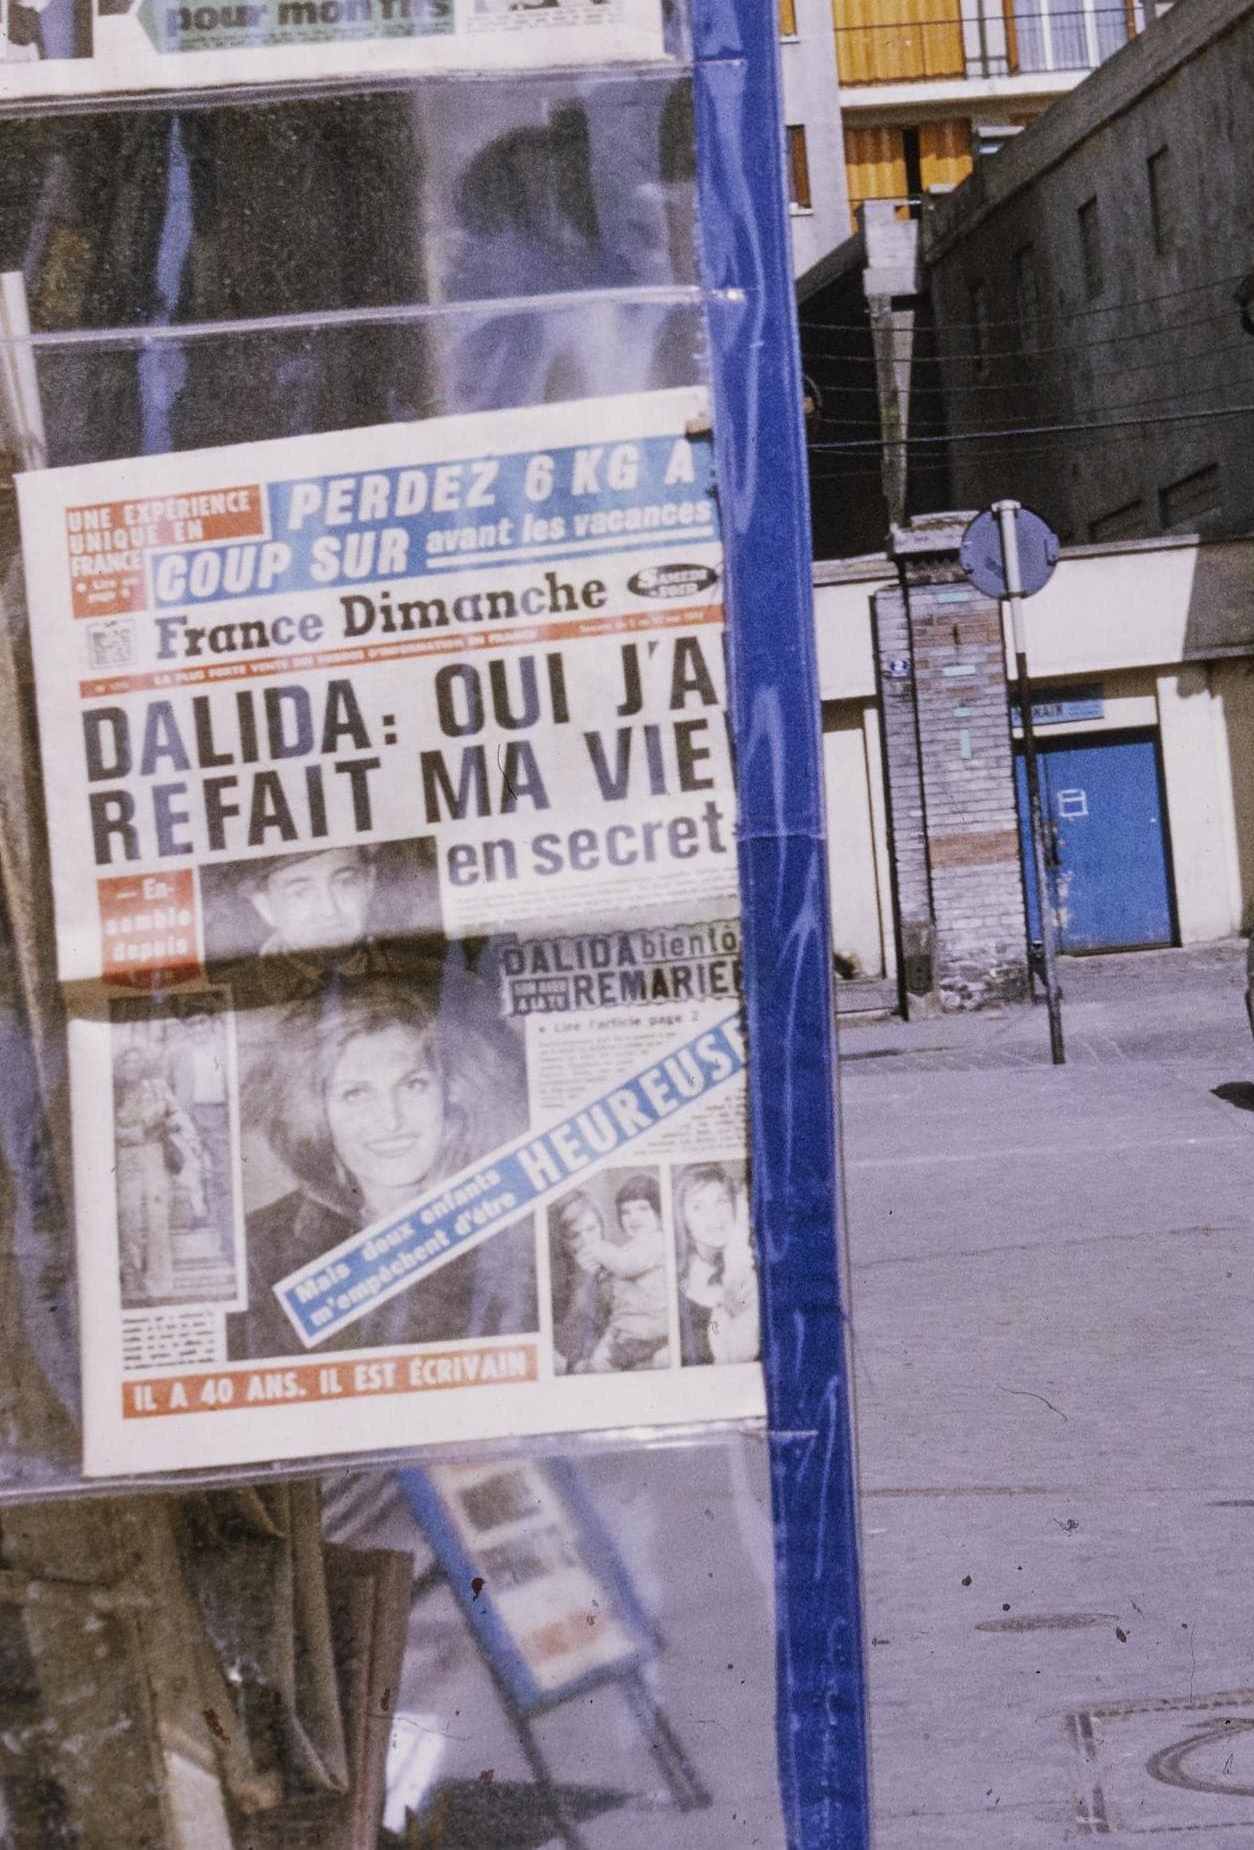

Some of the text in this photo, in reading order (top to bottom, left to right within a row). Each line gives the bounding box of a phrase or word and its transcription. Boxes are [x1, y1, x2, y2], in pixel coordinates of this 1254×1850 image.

[166, 4, 267, 37] pour
[278, 0, 372, 25] mon
[288, 438, 696, 530] PERDEZ 6 KG A
[68, 507, 112, 532] UNE
[69, 519, 203, 554] UNIQUE EN
[70, 550, 142, 577] FRANCE
[157, 542, 292, 601] COUP
[310, 527, 409, 583] SUR
[426, 515, 513, 554] avant
[522, 513, 566, 543] les
[574, 500, 712, 536] vacances
[154, 613, 323, 660] France
[339, 571, 607, 638] Dimanche
[435, 652, 570, 738] OUI
[617, 632, 728, 717] J'A
[88, 718, 715, 864] REFAIT MA VIE
[447, 801, 727, 886] en secret
[504, 925, 737, 976] DALIDA bientô
[294, 1262, 351, 1303] Mais
[133, 1385, 157, 1411] IL
[170, 1383, 188, 1408] A
[200, 1379, 233, 1406] 40
[320, 1367, 343, 1395] IL
[355, 1361, 395, 1391] EST
[409, 1351, 528, 1387] ÉCRIVAIN
